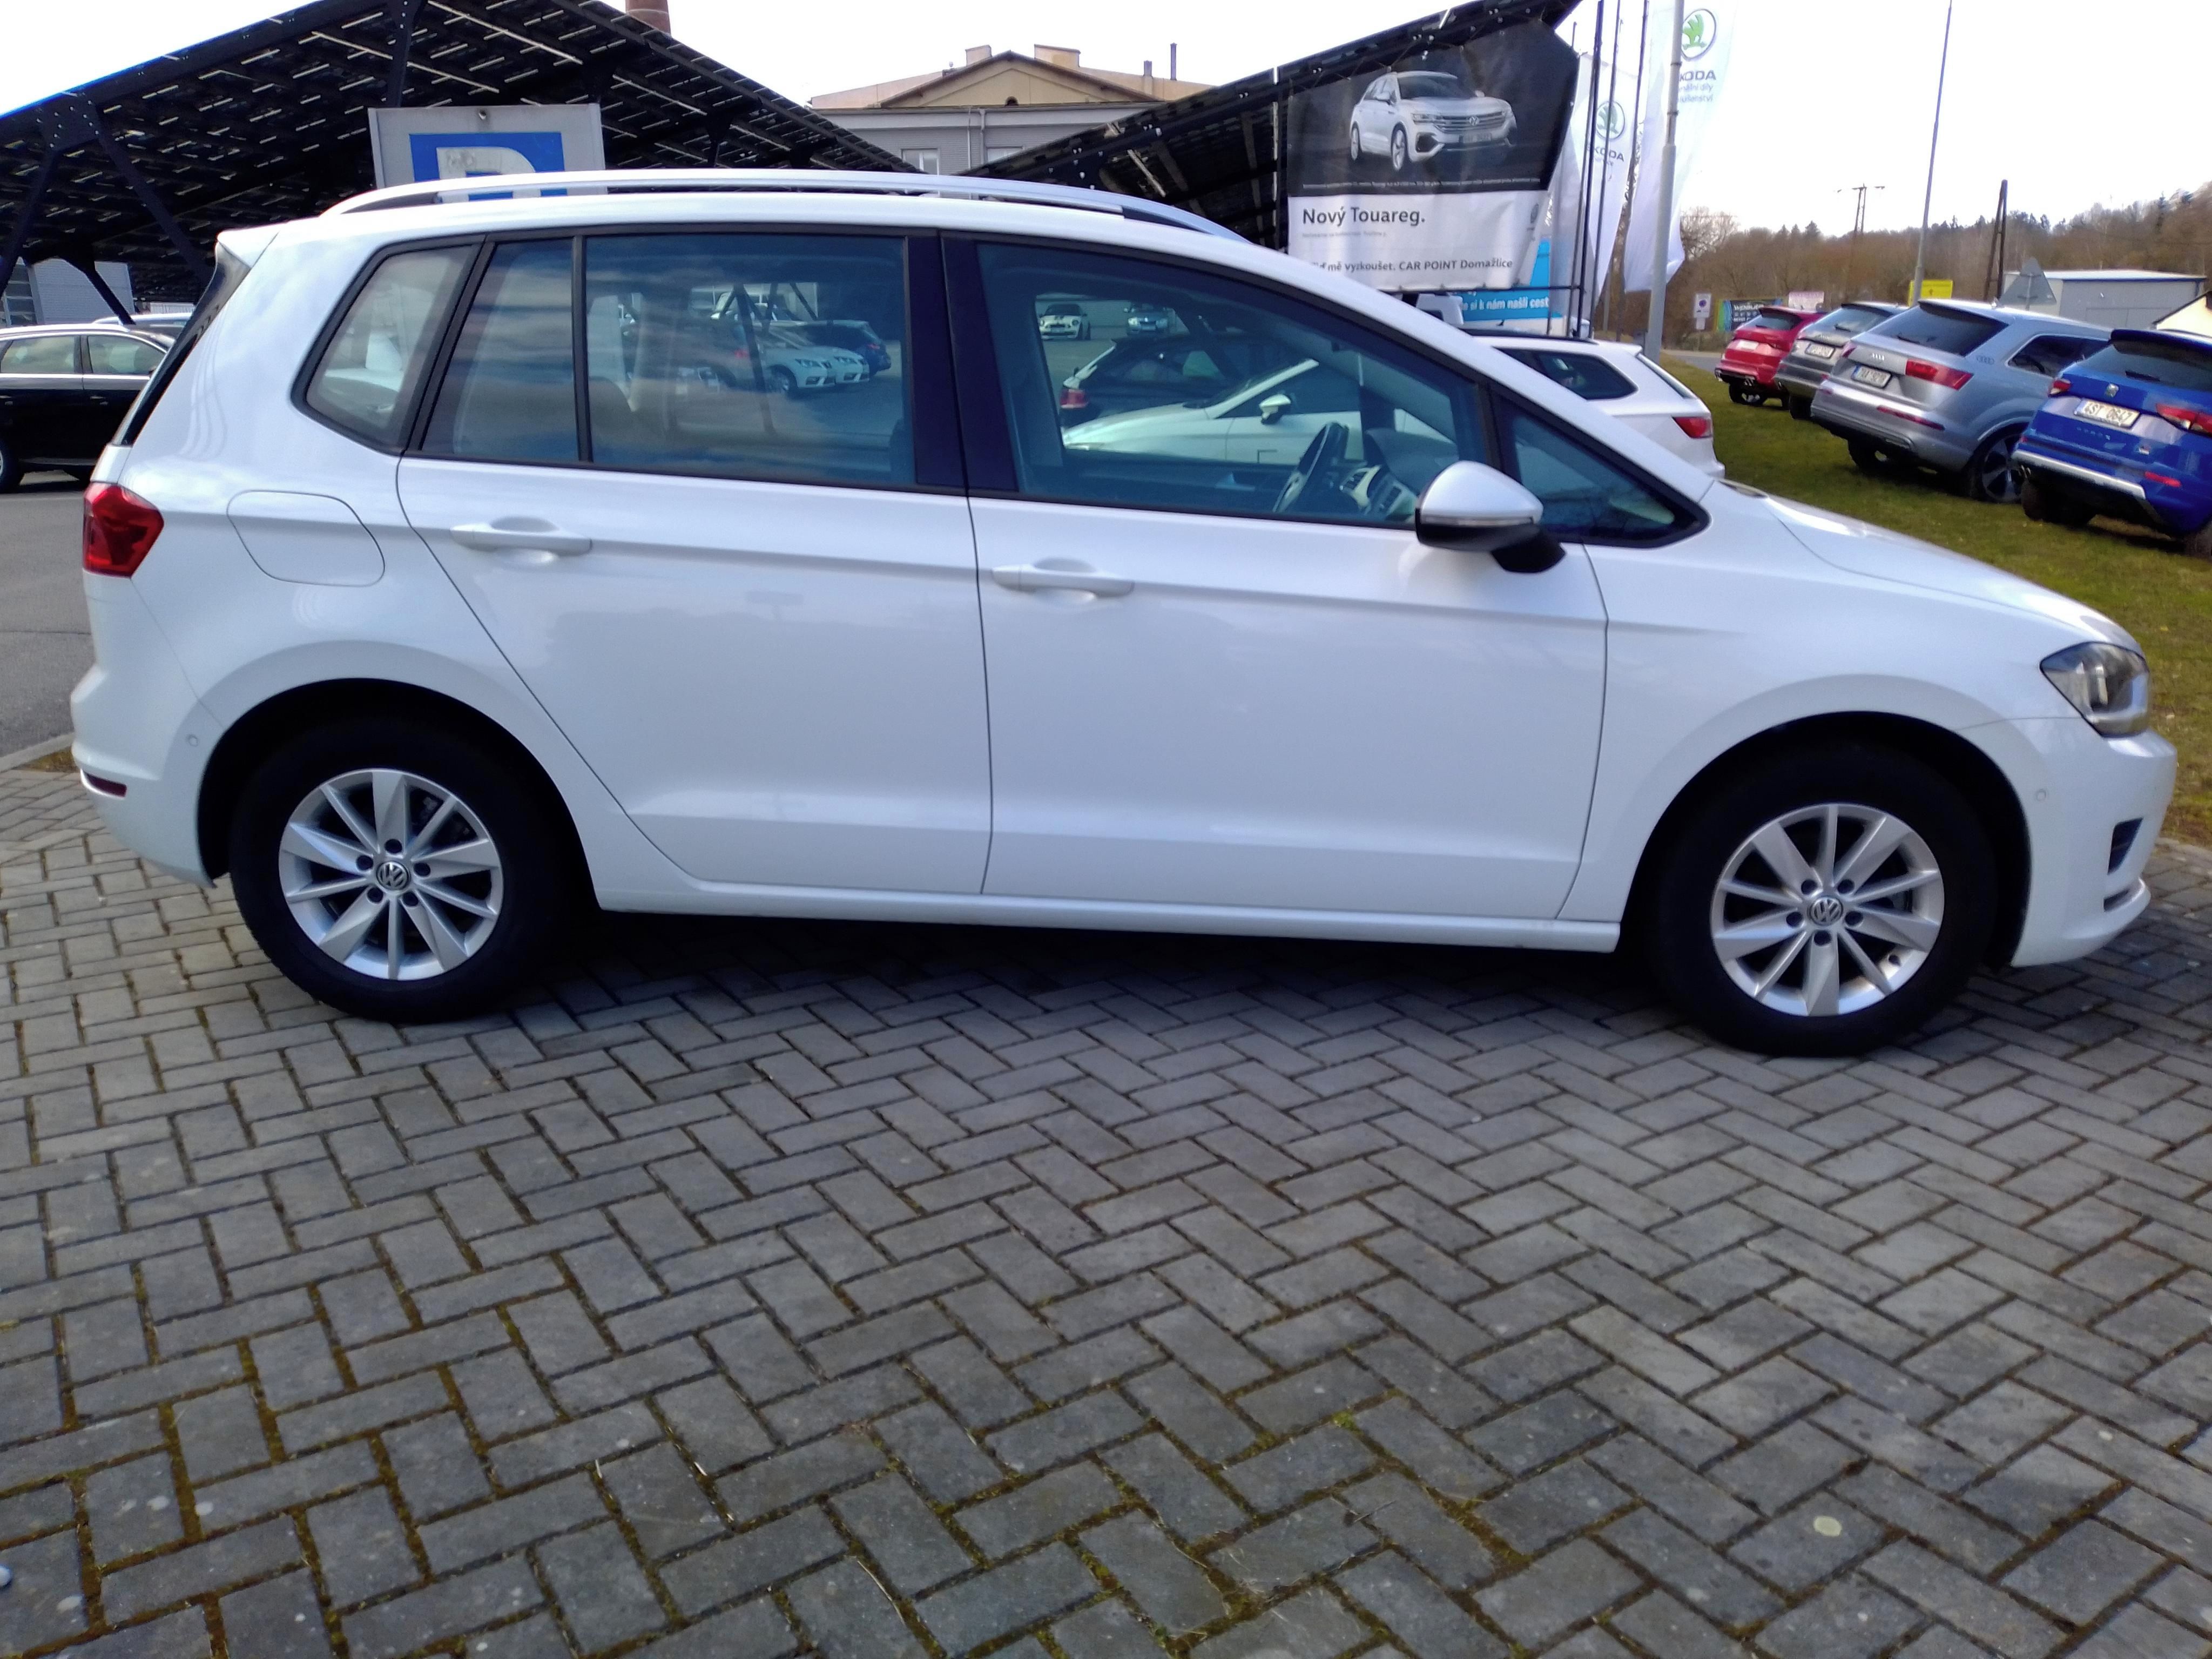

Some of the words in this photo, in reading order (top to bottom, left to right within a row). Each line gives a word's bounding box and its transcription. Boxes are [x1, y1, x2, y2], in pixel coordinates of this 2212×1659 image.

[1678, 70, 1716, 82] KODA
[1303, 206, 1346, 227] Nový
[1351, 206, 1425, 226] Touareg.
[1399, 261, 1421, 270] CAR
[1424, 260, 1457, 270] POINT
[1460, 258, 1512, 269] Domažlice
[1529, 296, 1549, 308] cest
